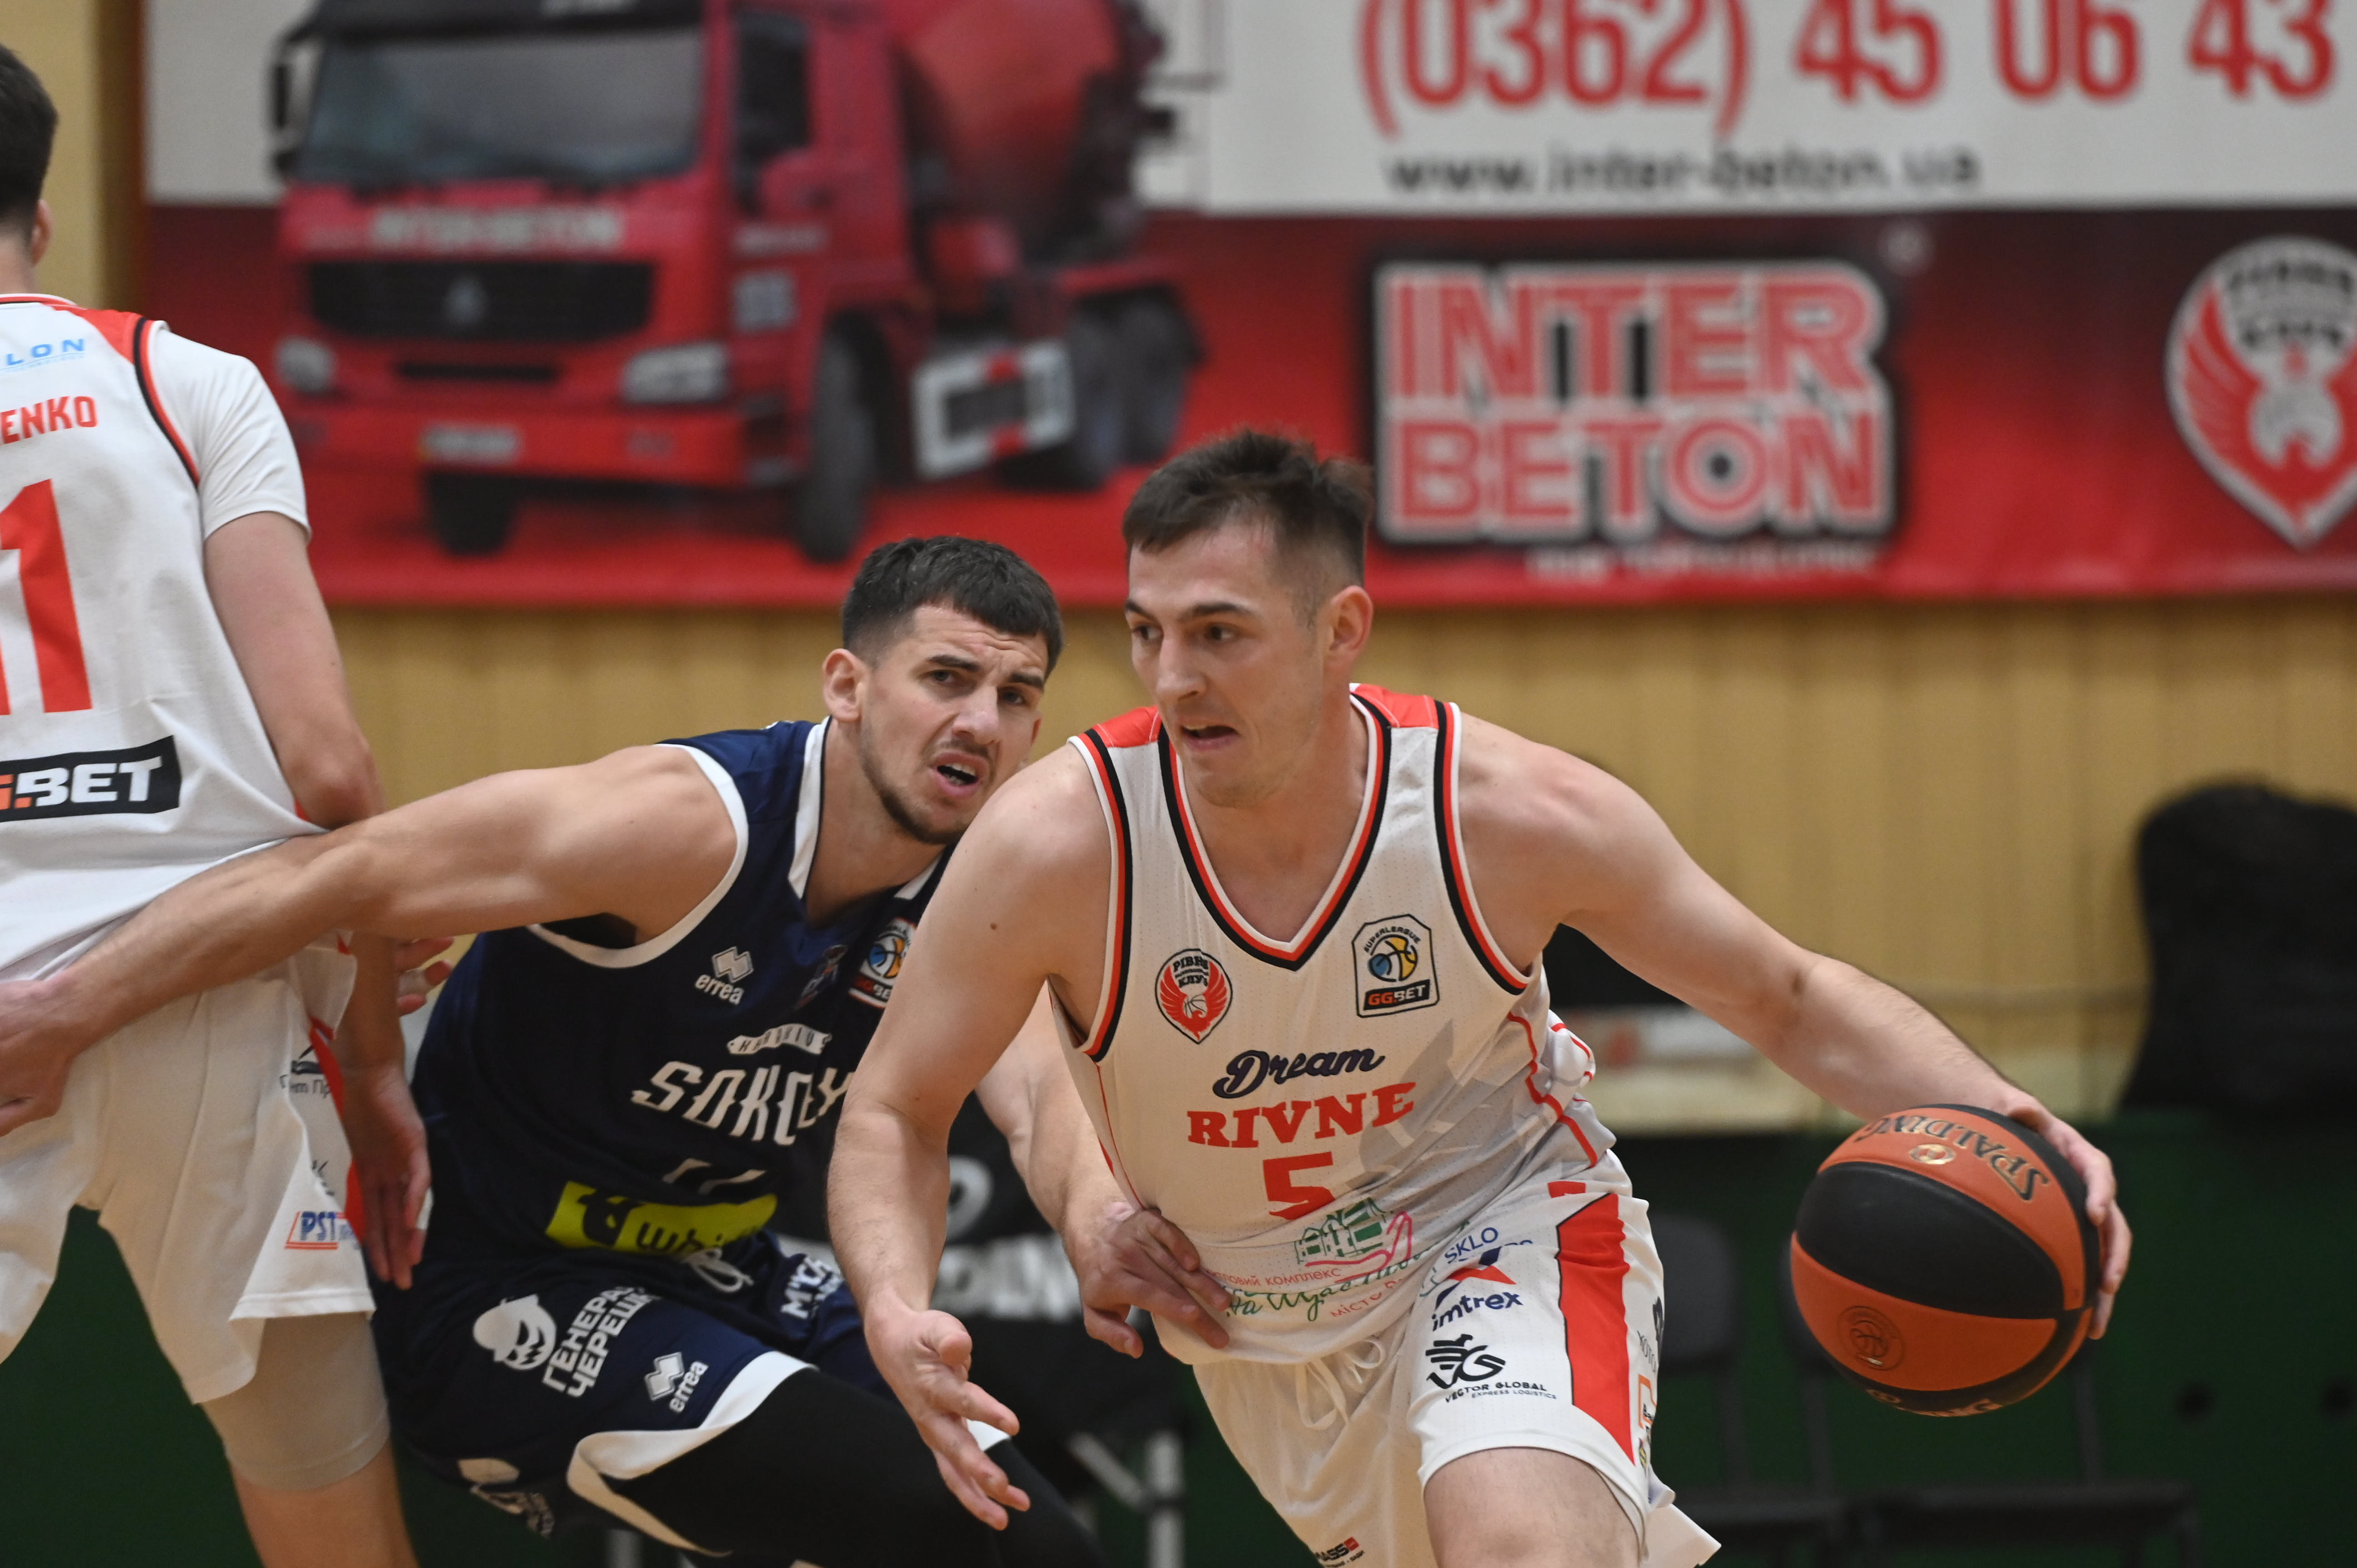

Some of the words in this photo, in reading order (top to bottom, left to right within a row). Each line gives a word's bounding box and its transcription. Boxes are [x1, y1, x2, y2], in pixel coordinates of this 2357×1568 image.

[1358, 0, 1751, 139] (0362)
[1792, 0, 1943, 105] 45
[1992, 0, 2144, 103] 06
[2186, 0, 2335, 102] 43
[1381, 265, 1879, 400] INTER
[1385, 406, 1888, 528] BETON
[1363, 926, 1421, 953] SUPERLEAGUE
[694, 974, 745, 1005] errea
[1212, 1048, 1386, 1099] Dream
[1186, 1081, 1416, 1148] RIVNE
[1852, 1114, 2051, 1202] SPALDING
[1262, 1151, 1336, 1220] 5
[1444, 1227, 1499, 1264] SKLO
[1431, 1292, 1524, 1332] imtrex
[669, 1360, 709, 1413] errea
[1445, 1384, 1489, 1403] VECTOR
[1495, 1381, 1547, 1392] GLOBAL
[1471, 1390, 1509, 1398] EXPRESS
[1513, 1390, 1557, 1399] LOGISTICS
